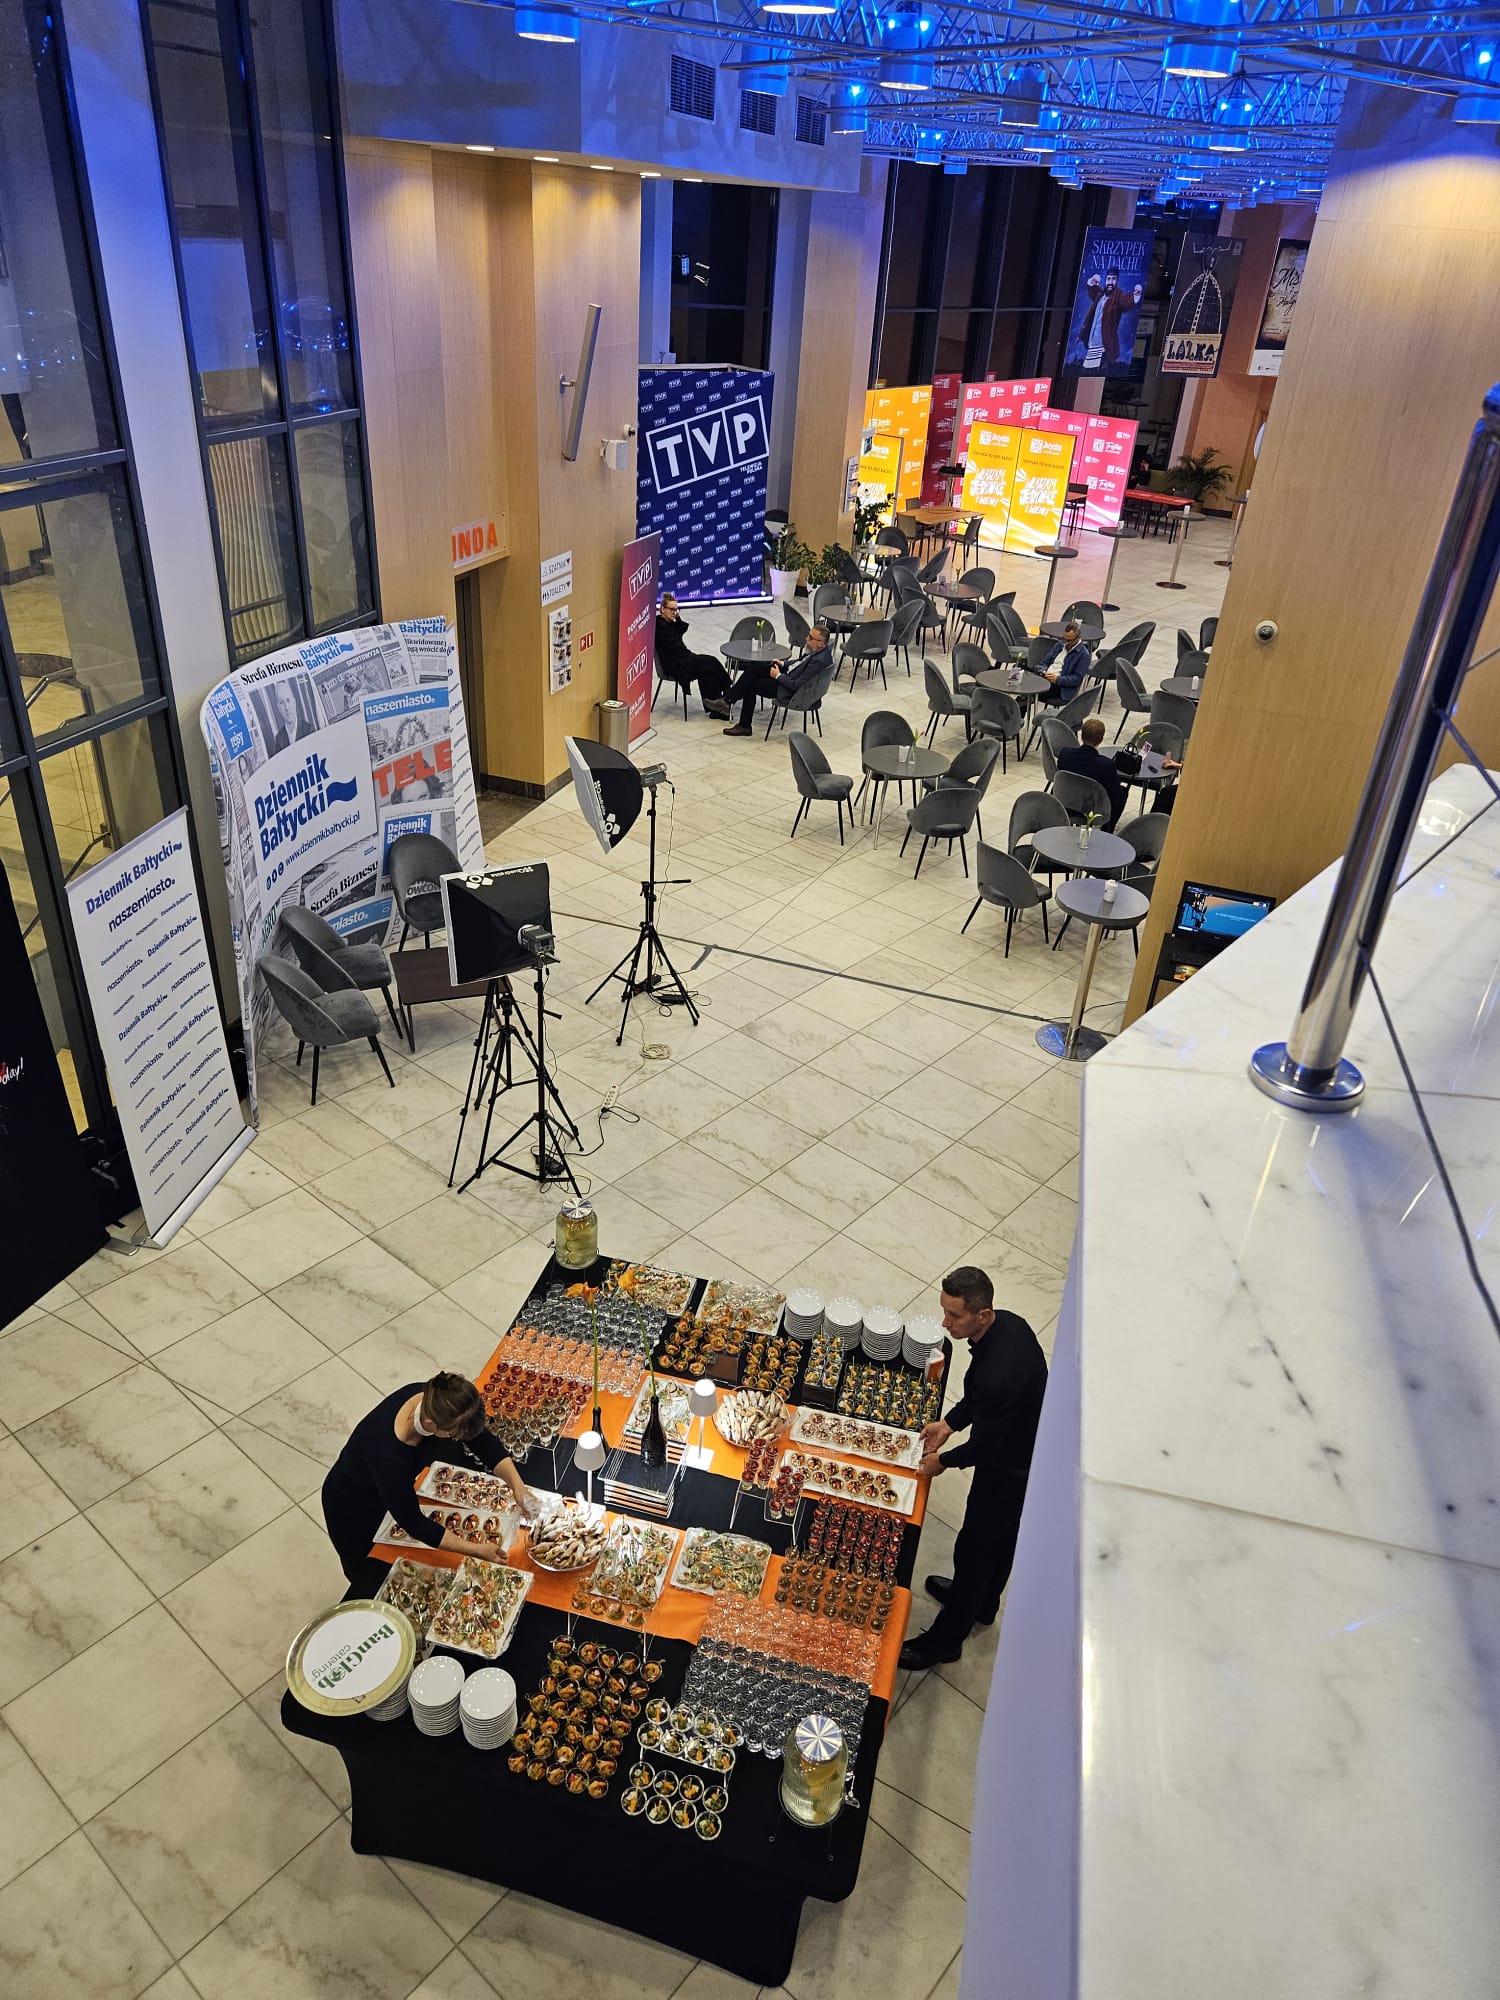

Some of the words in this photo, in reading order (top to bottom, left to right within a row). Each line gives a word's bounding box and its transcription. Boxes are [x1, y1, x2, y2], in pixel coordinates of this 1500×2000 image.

[1090, 255, 1105, 269] NA
[1107, 255, 1142, 270] DACHU
[1091, 240, 1146, 256] SKRZYPEK
[1273, 267, 1300, 290] Mis
[1167, 340, 1216, 361] LALKA
[654, 410, 759, 480] TVP
[630, 560, 651, 596] TVP
[399, 624, 443, 636] Bałtycki
[299, 636, 339, 660] Dziennik
[305, 645, 341, 671] Bałtycki
[240, 667, 267, 686] Strefa
[266, 658, 304, 677] Biznesu
[628, 651, 646, 684] TVP
[372, 738, 452, 798] TELE
[254, 753, 330, 829] Dziennik
[260, 783, 326, 861] Bałtycki
[387, 818, 428, 834] Dziennik
[85, 871, 133, 915] Dziennik
[132, 840, 173, 880] Bałtycki
[310, 886, 339, 912] Strefa
[339, 861, 378, 891] Biznesu
[147, 934, 170, 957] Dziennik
[169, 915, 193, 938] Bałtycki
[118, 1015, 141, 1041] Dziennik
[140, 994, 163, 1019] Bałtycki
[167, 1025, 189, 1049] Dziennik
[188, 1006, 210, 1028] Bałtycki
[0, 1056, 25, 1085] day!
[140, 1106, 161, 1133] Dziennik
[161, 1084, 182, 1109] Bałtycki
[185, 1110, 207, 1135] Dziennik
[311, 1644, 352, 1679] catering
